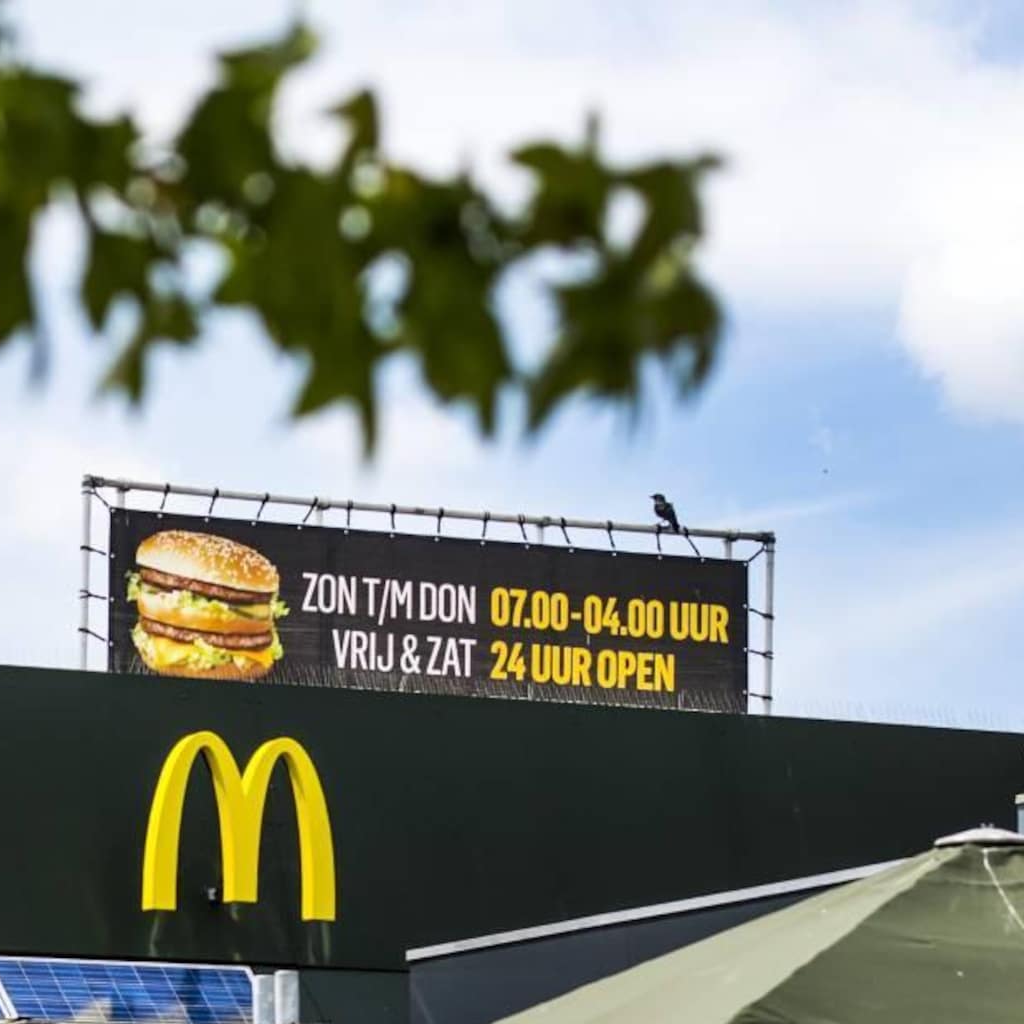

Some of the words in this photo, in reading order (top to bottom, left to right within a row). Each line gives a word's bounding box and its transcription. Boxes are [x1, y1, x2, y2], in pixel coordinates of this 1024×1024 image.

[302, 572, 357, 616] ZON
[362, 577, 413, 626] T/M
[419, 581, 476, 625] DON
[490, 586, 665, 639] 07.00-04.00
[669, 601, 729, 644] UUR
[332, 629, 394, 673] VRIJ
[400, 634, 421, 674] &
[426, 636, 477, 678] ZAT
[490, 640, 525, 681] 24
[531, 643, 592, 687] UUR
[597, 649, 675, 692] OPEN
